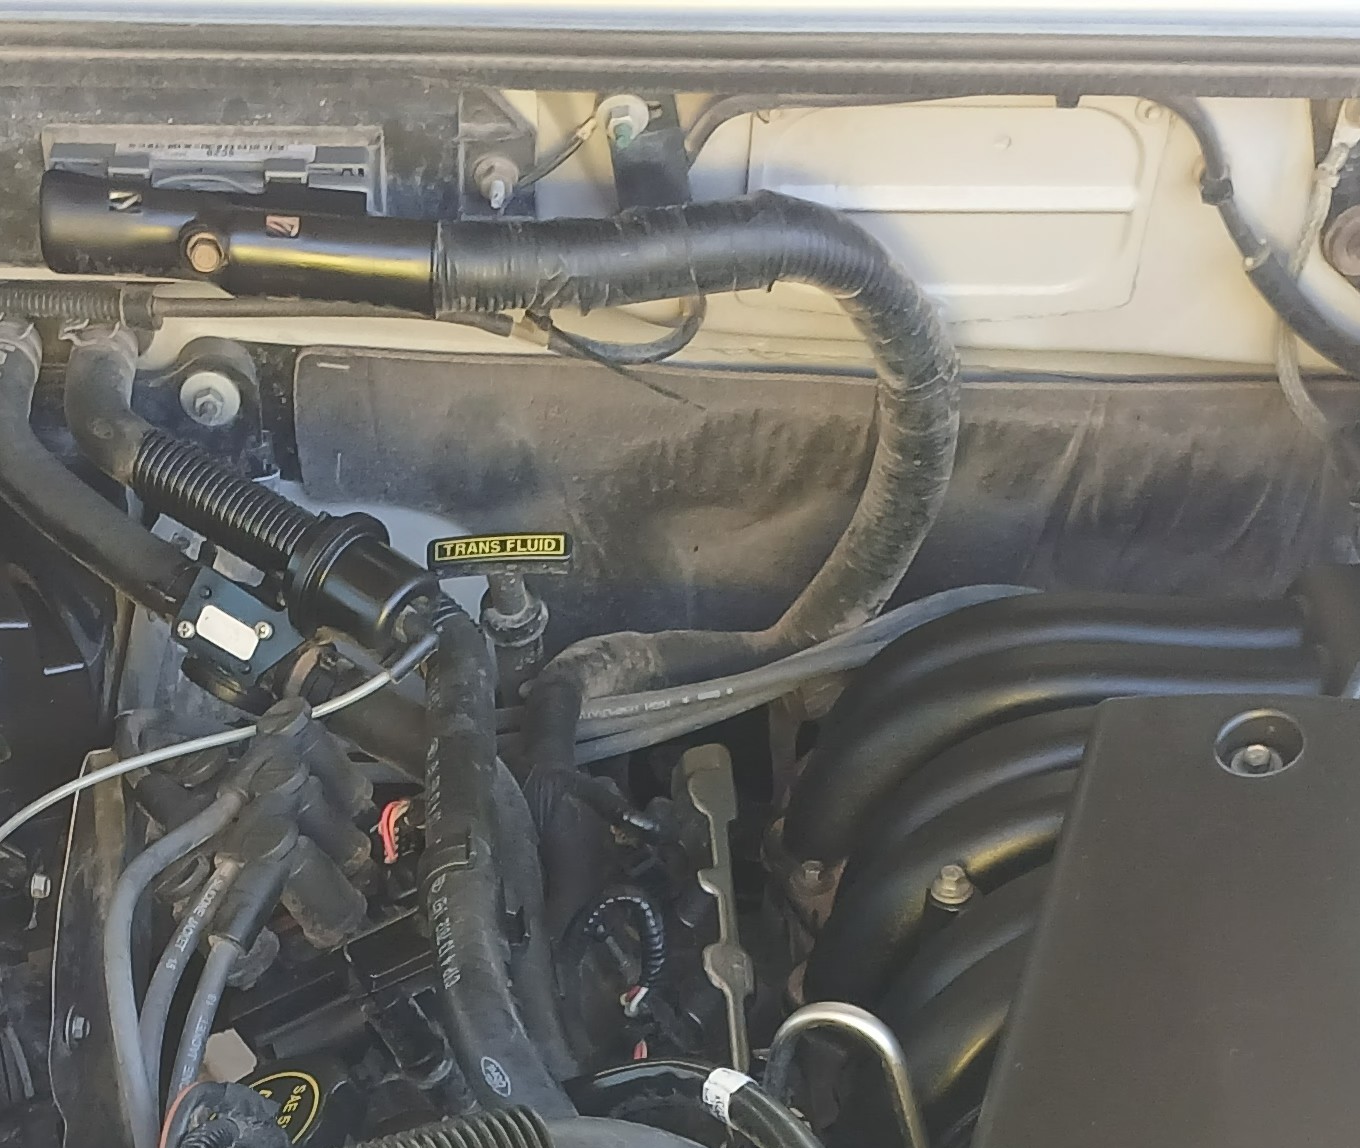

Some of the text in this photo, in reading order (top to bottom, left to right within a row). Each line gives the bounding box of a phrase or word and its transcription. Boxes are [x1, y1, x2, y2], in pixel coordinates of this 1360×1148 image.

[442, 538, 557, 556] TRANS FLUID
[282, 1084, 307, 1113] SAE
